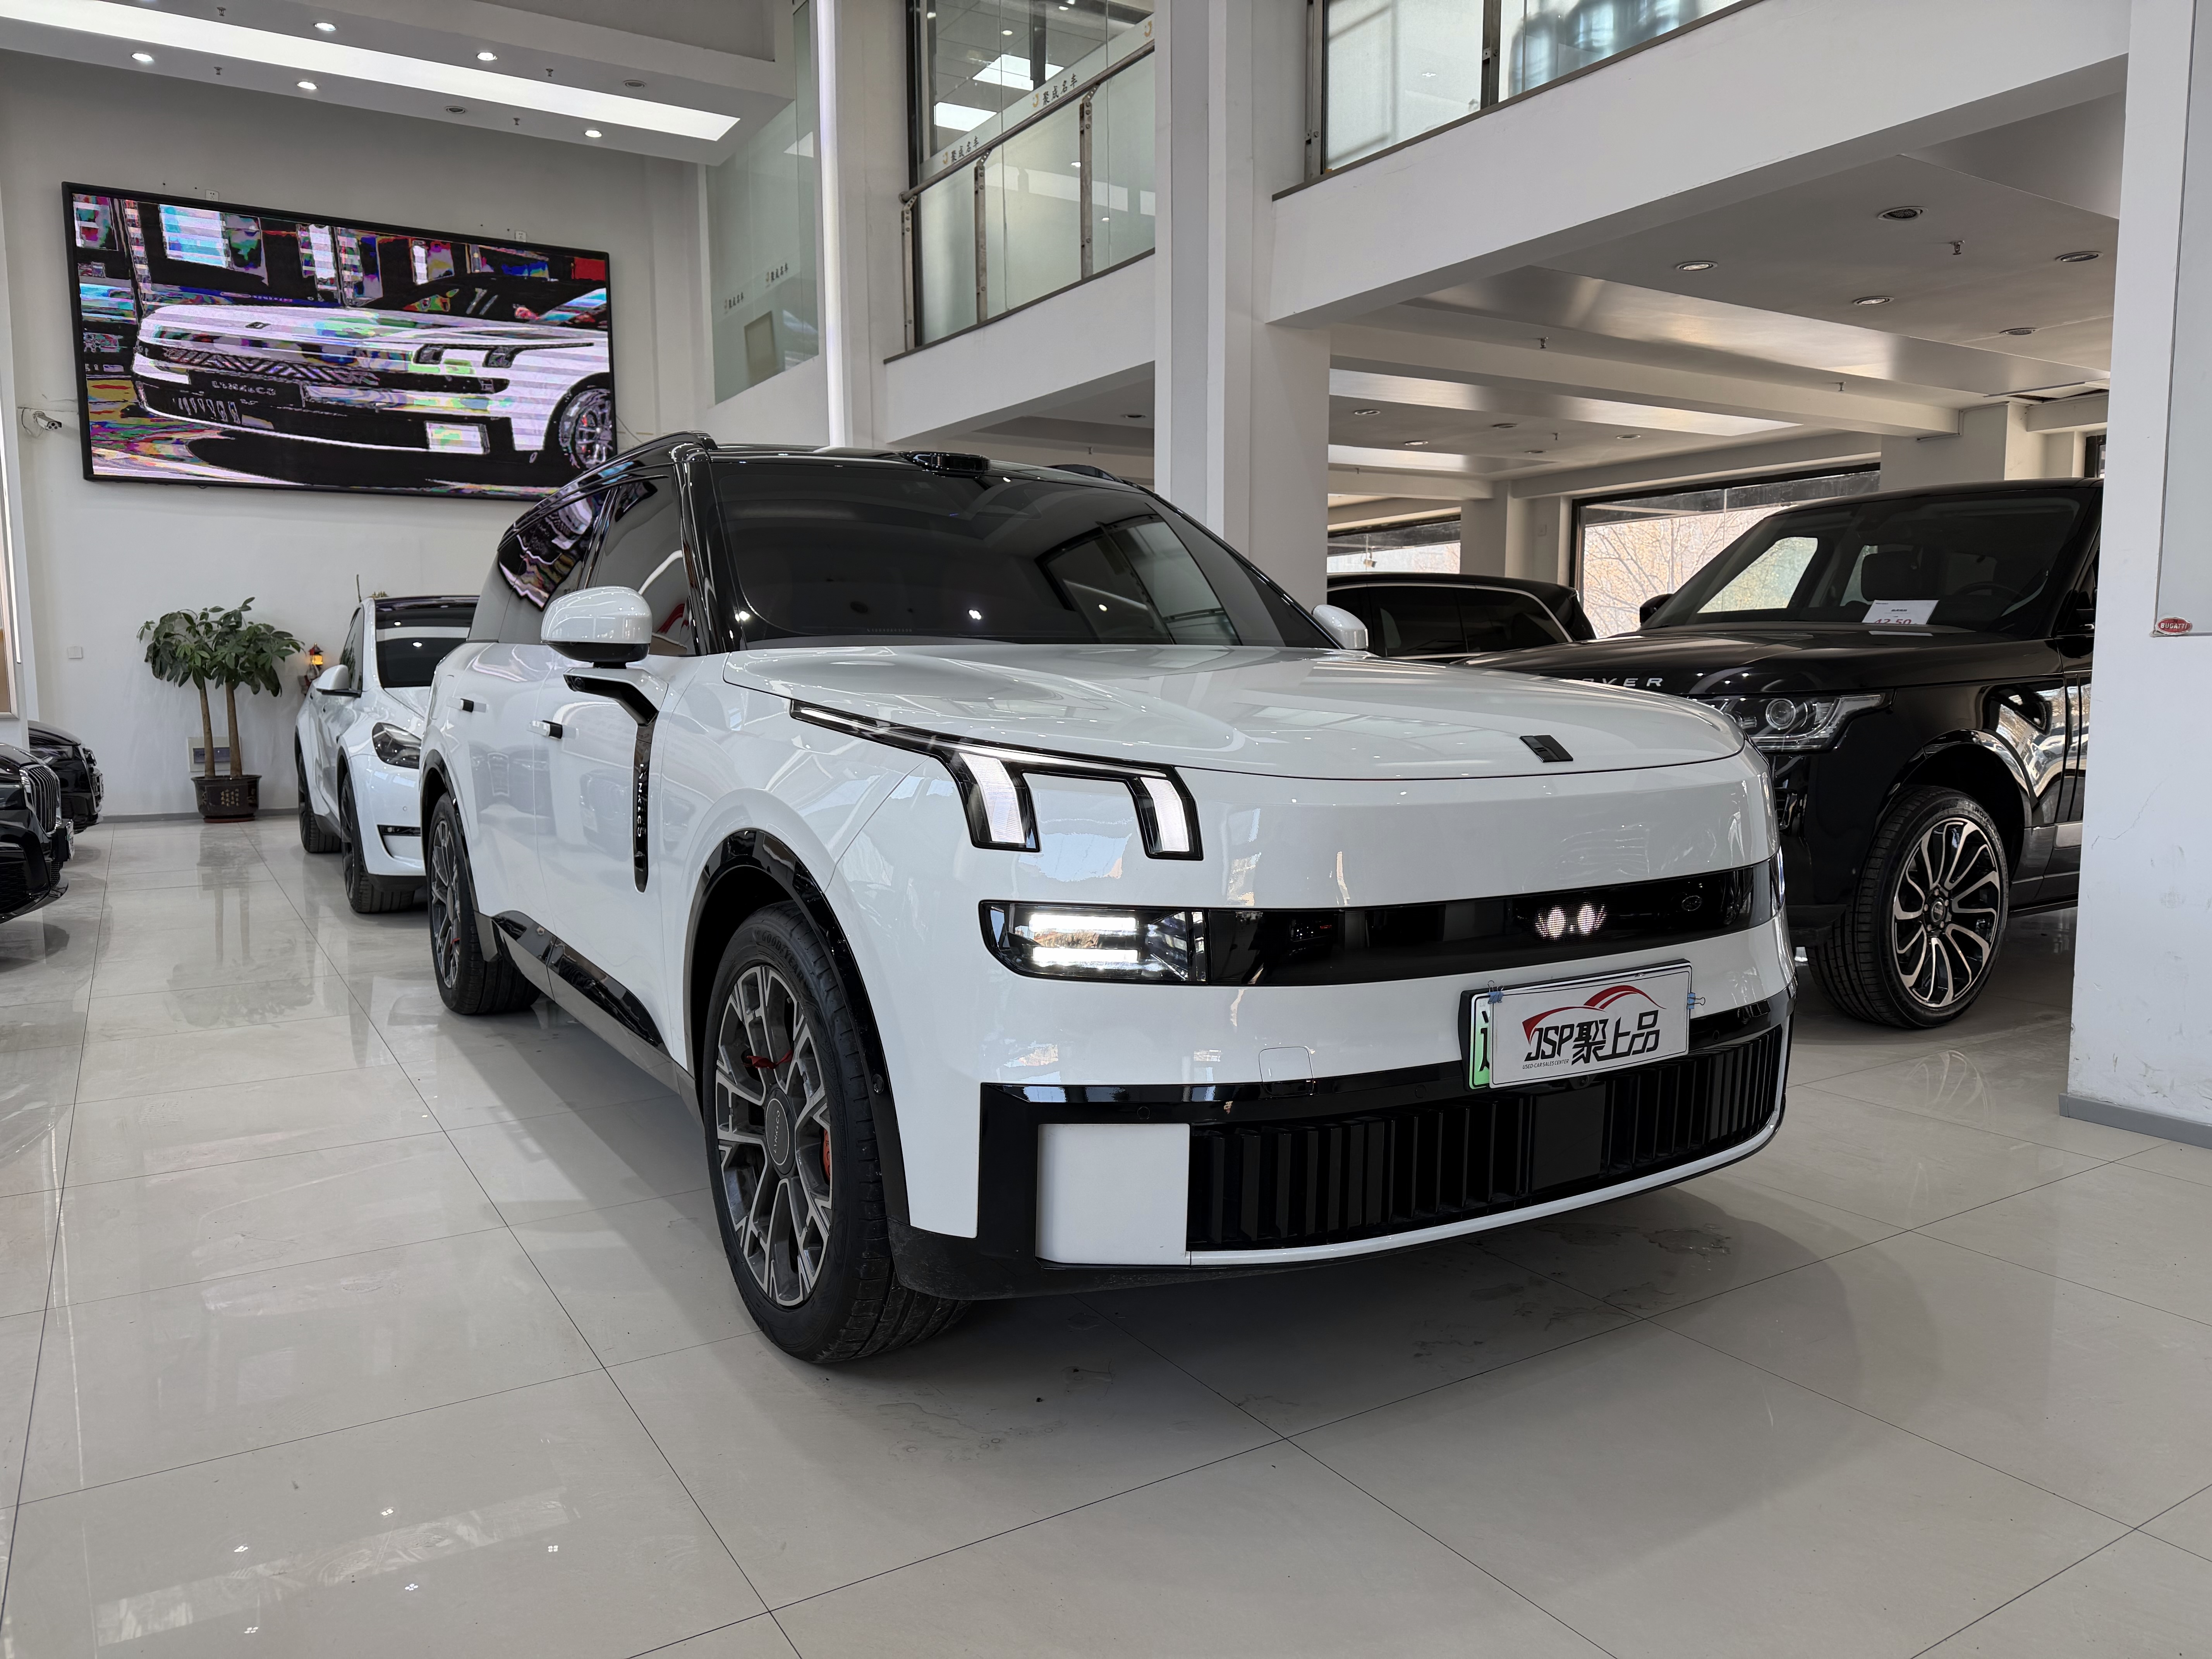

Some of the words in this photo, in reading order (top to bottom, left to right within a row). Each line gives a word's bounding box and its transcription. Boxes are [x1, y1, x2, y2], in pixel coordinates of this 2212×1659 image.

[1524, 1024, 1575, 1061] JSP
[1571, 1010, 1660, 1065] 聚上品
